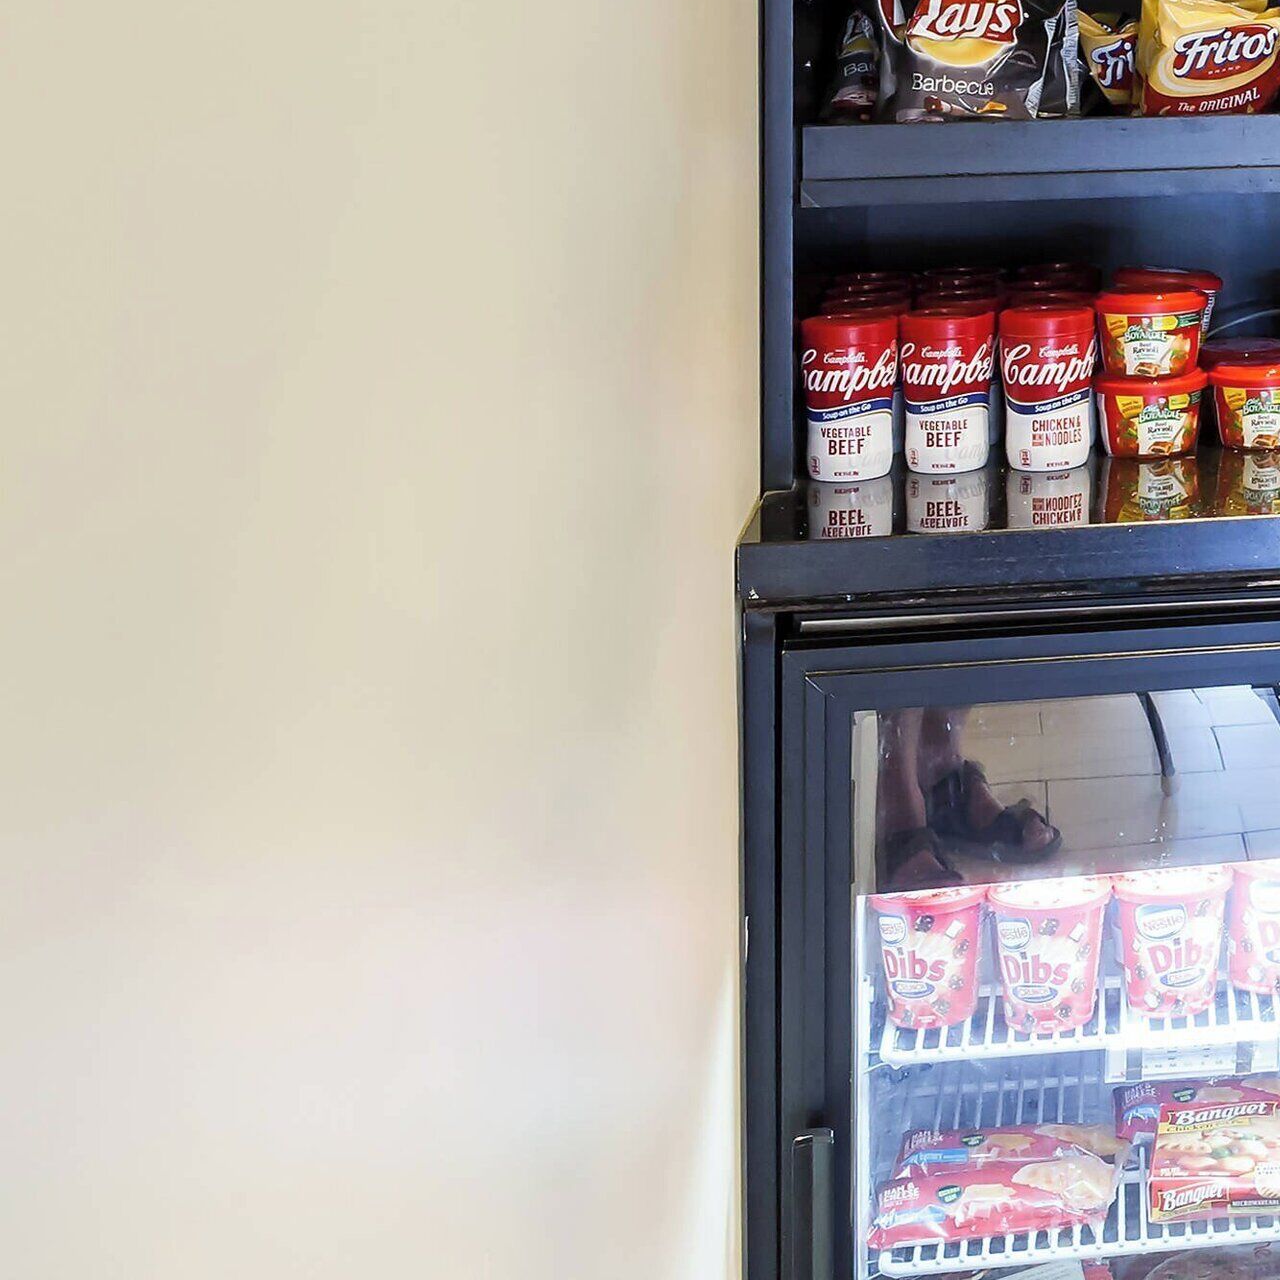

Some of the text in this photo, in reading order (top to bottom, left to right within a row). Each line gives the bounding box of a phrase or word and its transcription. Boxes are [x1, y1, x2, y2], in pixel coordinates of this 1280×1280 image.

[1173, 26, 1279, 77] Fritos
[1091, 40, 1135, 88] Fri
[911, 72, 994, 96] Barbecue
[1177, 86, 1260, 112] The ORIGINAL
[1124, 329, 1167, 342] BOYARDEE
[823, 352, 867, 365] Campbell's
[921, 346, 965, 358] Campbell's
[1038, 344, 1080, 358] Campbell's
[801, 348, 897, 400] ampbe
[901, 342, 993, 394] ampbe
[1004, 338, 1096, 392] Campb
[920, 396, 968, 413] Soup on Go
[1072, 394, 1082, 403] Go
[822, 403, 871, 421] Soup on Go
[1139, 409, 1180, 423] BOYARDEE
[821, 426, 871, 438] VEGETABLE
[919, 419, 968, 431] VEGETABLE
[1032, 415, 1082, 433] CHICKEN &
[926, 431, 961, 448] BEEF
[1046, 428, 1082, 446] NOODLES
[828, 439, 865, 455] BEEF
[883, 946, 946, 981] Dibs
[1149, 939, 1214, 972] Dibs
[1003, 951, 1071, 985] Dibs
[1175, 1102, 1268, 1125] Banquet
[1163, 1183, 1224, 1212] Banquet
